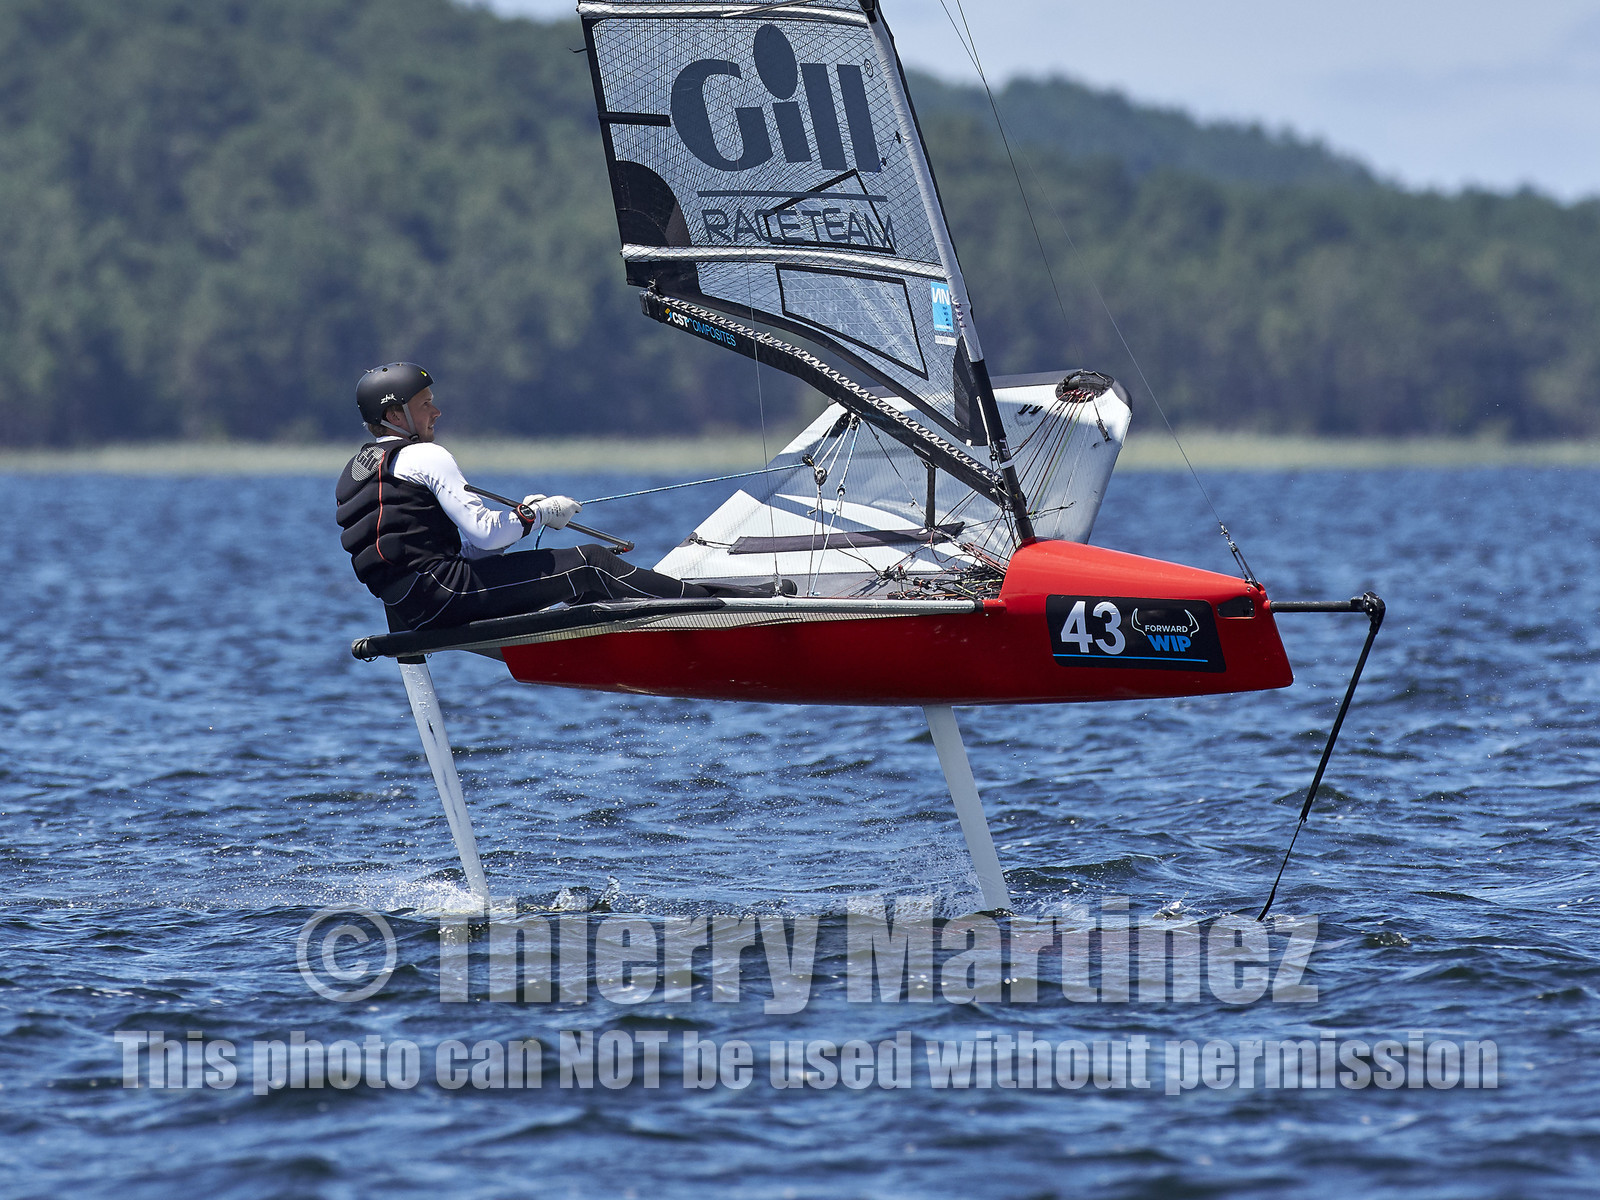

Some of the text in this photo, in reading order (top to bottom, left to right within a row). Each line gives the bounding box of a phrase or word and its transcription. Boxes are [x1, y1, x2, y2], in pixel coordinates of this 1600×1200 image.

[1061, 600, 1126, 655] 43
[1144, 624, 1188, 634] FORWARD
[1147, 634, 1192, 652] WIP
